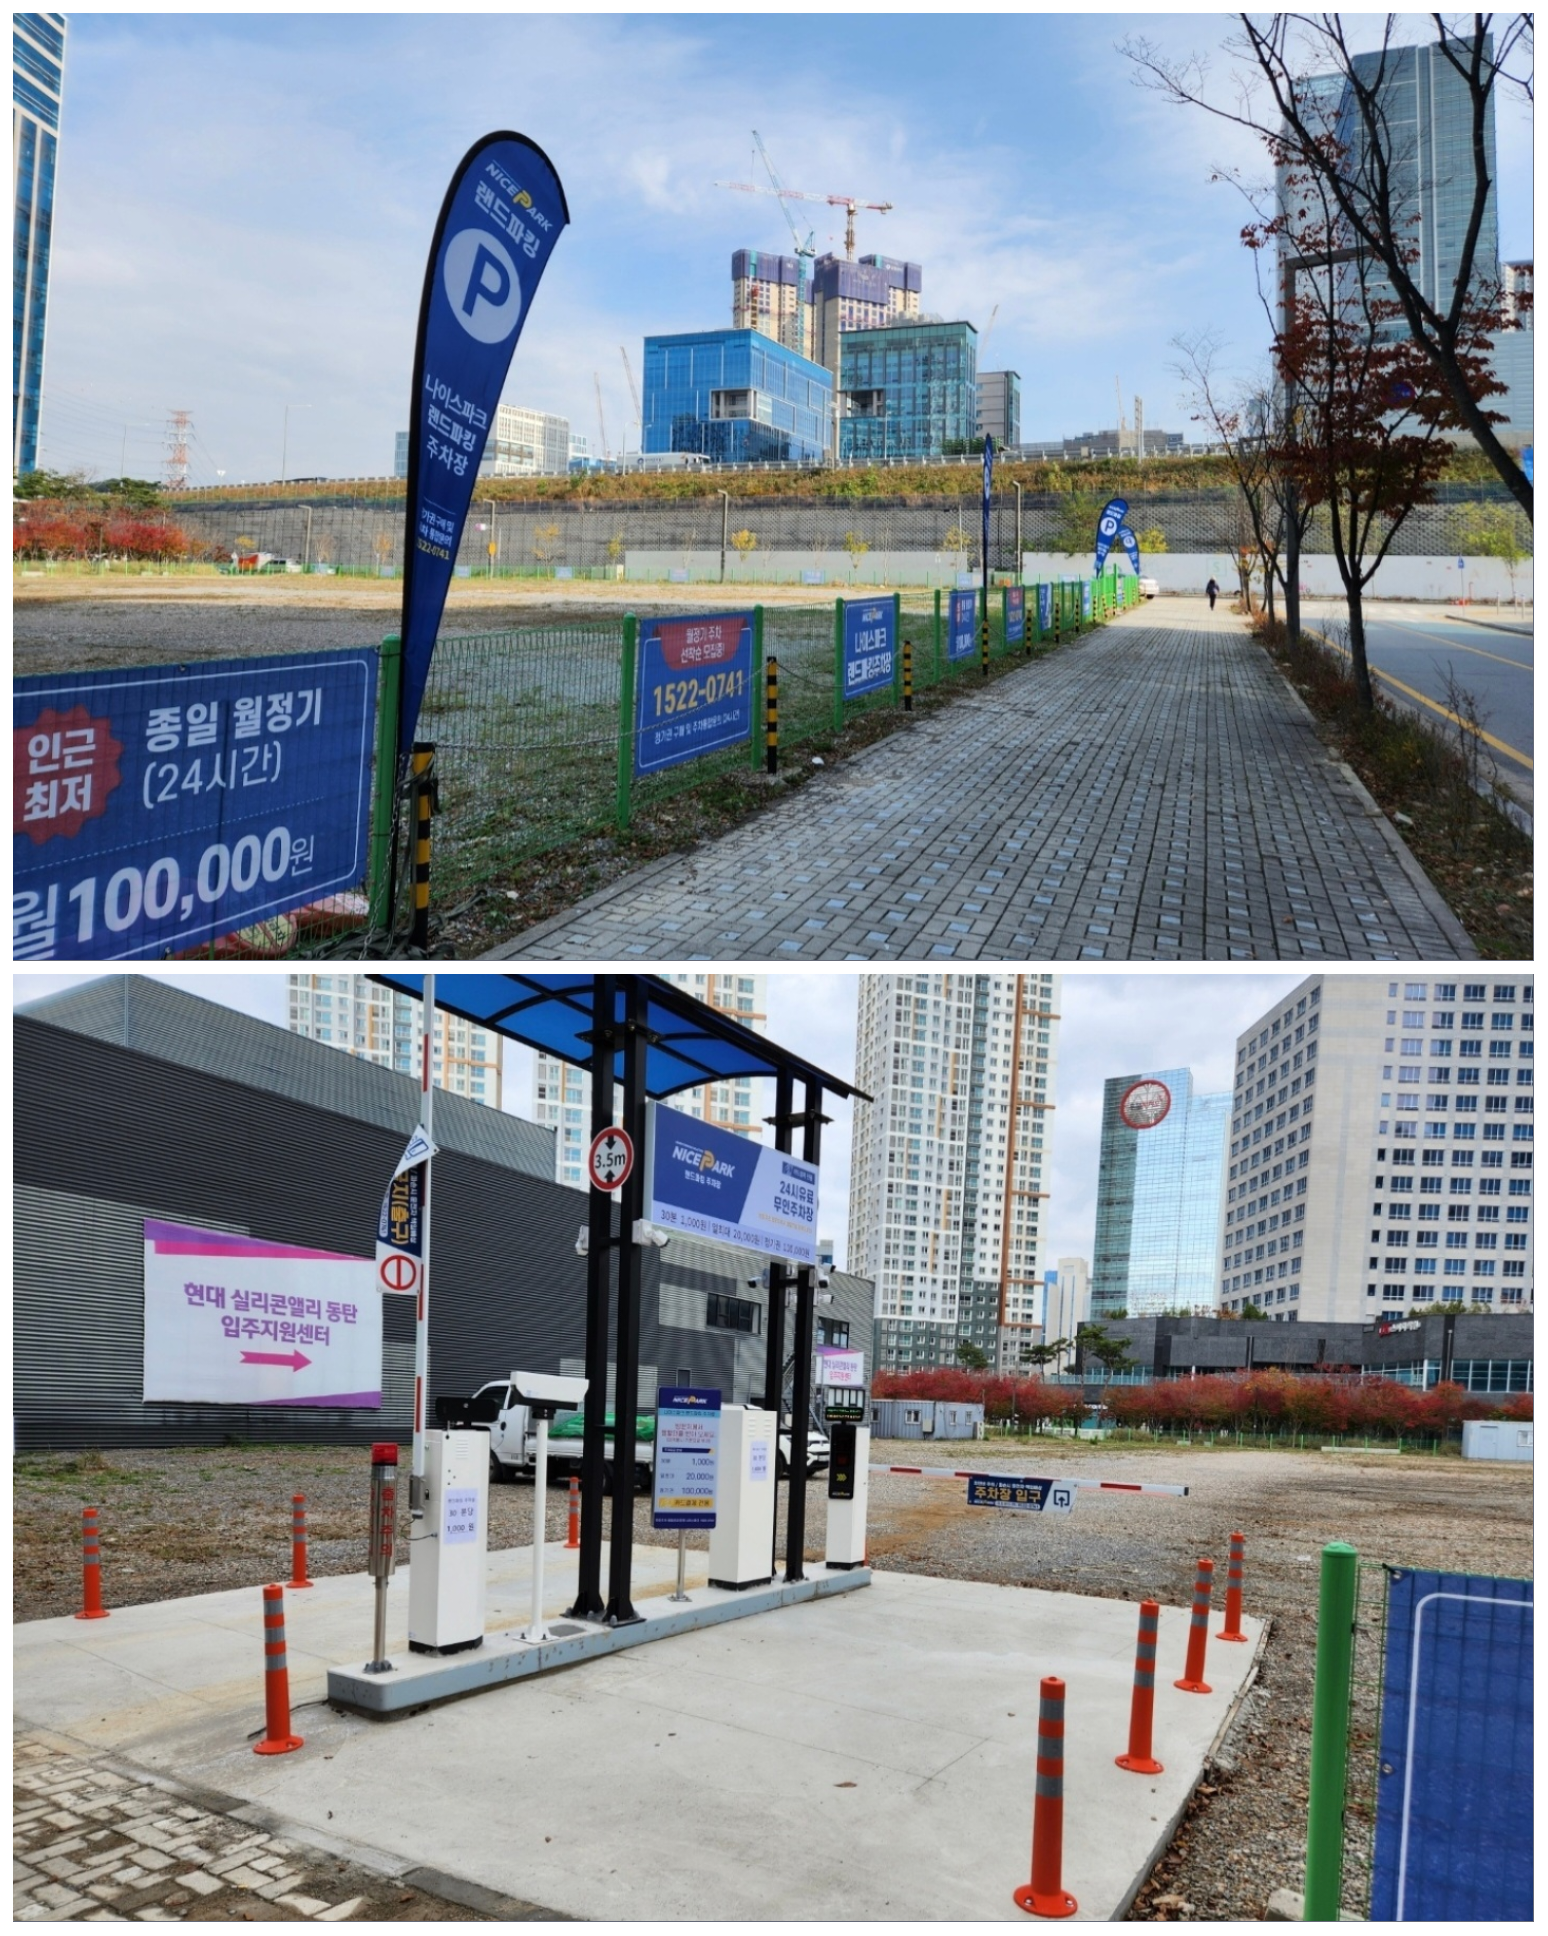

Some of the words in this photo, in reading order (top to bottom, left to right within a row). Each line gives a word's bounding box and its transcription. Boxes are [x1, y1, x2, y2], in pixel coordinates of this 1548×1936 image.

[485, 162, 553, 232] NICEPARK
[474, 180, 541, 259] 랜드파킹
[462, 242, 510, 318] P
[425, 373, 487, 430] 나이스파크
[428, 403, 476, 452] 랜드파킹
[427, 434, 468, 476] 주차장
[446, 520, 455, 534] 및
[1105, 519, 1115, 532] P
[686, 626, 708, 644] 월정기
[708, 624, 722, 640] 주차
[854, 627, 887, 653] 나이스파크
[681, 648, 702, 663] 선착순
[654, 669, 743, 717] 1522-0741
[145, 702, 219, 753] 종일
[233, 687, 323, 739] 월정기
[654, 729, 673, 745] 정기권
[673, 725, 685, 739] 구매
[686, 724, 692, 735] 및
[27, 728, 97, 775] 인근
[142, 740, 282, 809] (24시간)
[22, 774, 92, 822] 최저
[69, 826, 315, 943] 100,000원
[595, 1152, 626, 1169] 3.5m
[672, 1146, 736, 1178] NICEPARK
[684, 1169, 706, 1185] 랜드파킹
[706, 1176, 722, 1190] 주차장
[780, 1180, 814, 1206] 24시유료
[774, 1196, 814, 1223] 무인주차장
[661, 1209, 677, 1225] 30분
[680, 1214, 707, 1232] 1,000원
[711, 1222, 731, 1238] 일최대
[733, 1229, 761, 1247] 20,000원
[764, 1236, 781, 1252] 정기권
[184, 1281, 226, 1309] 현대
[230, 1288, 322, 1321] 실리콘앨리
[326, 1300, 358, 1325] 동탄
[221, 1315, 330, 1347] 입주지원센터
[686, 1472, 714, 1481] 20,000원
[974, 1486, 1012, 1502] 주차장
[1015, 1489, 1042, 1503] 입구
[447, 1524, 466, 1534] 1,000
[467, 1522, 474, 1531] 원
[449, 1509, 457, 1517] 30
